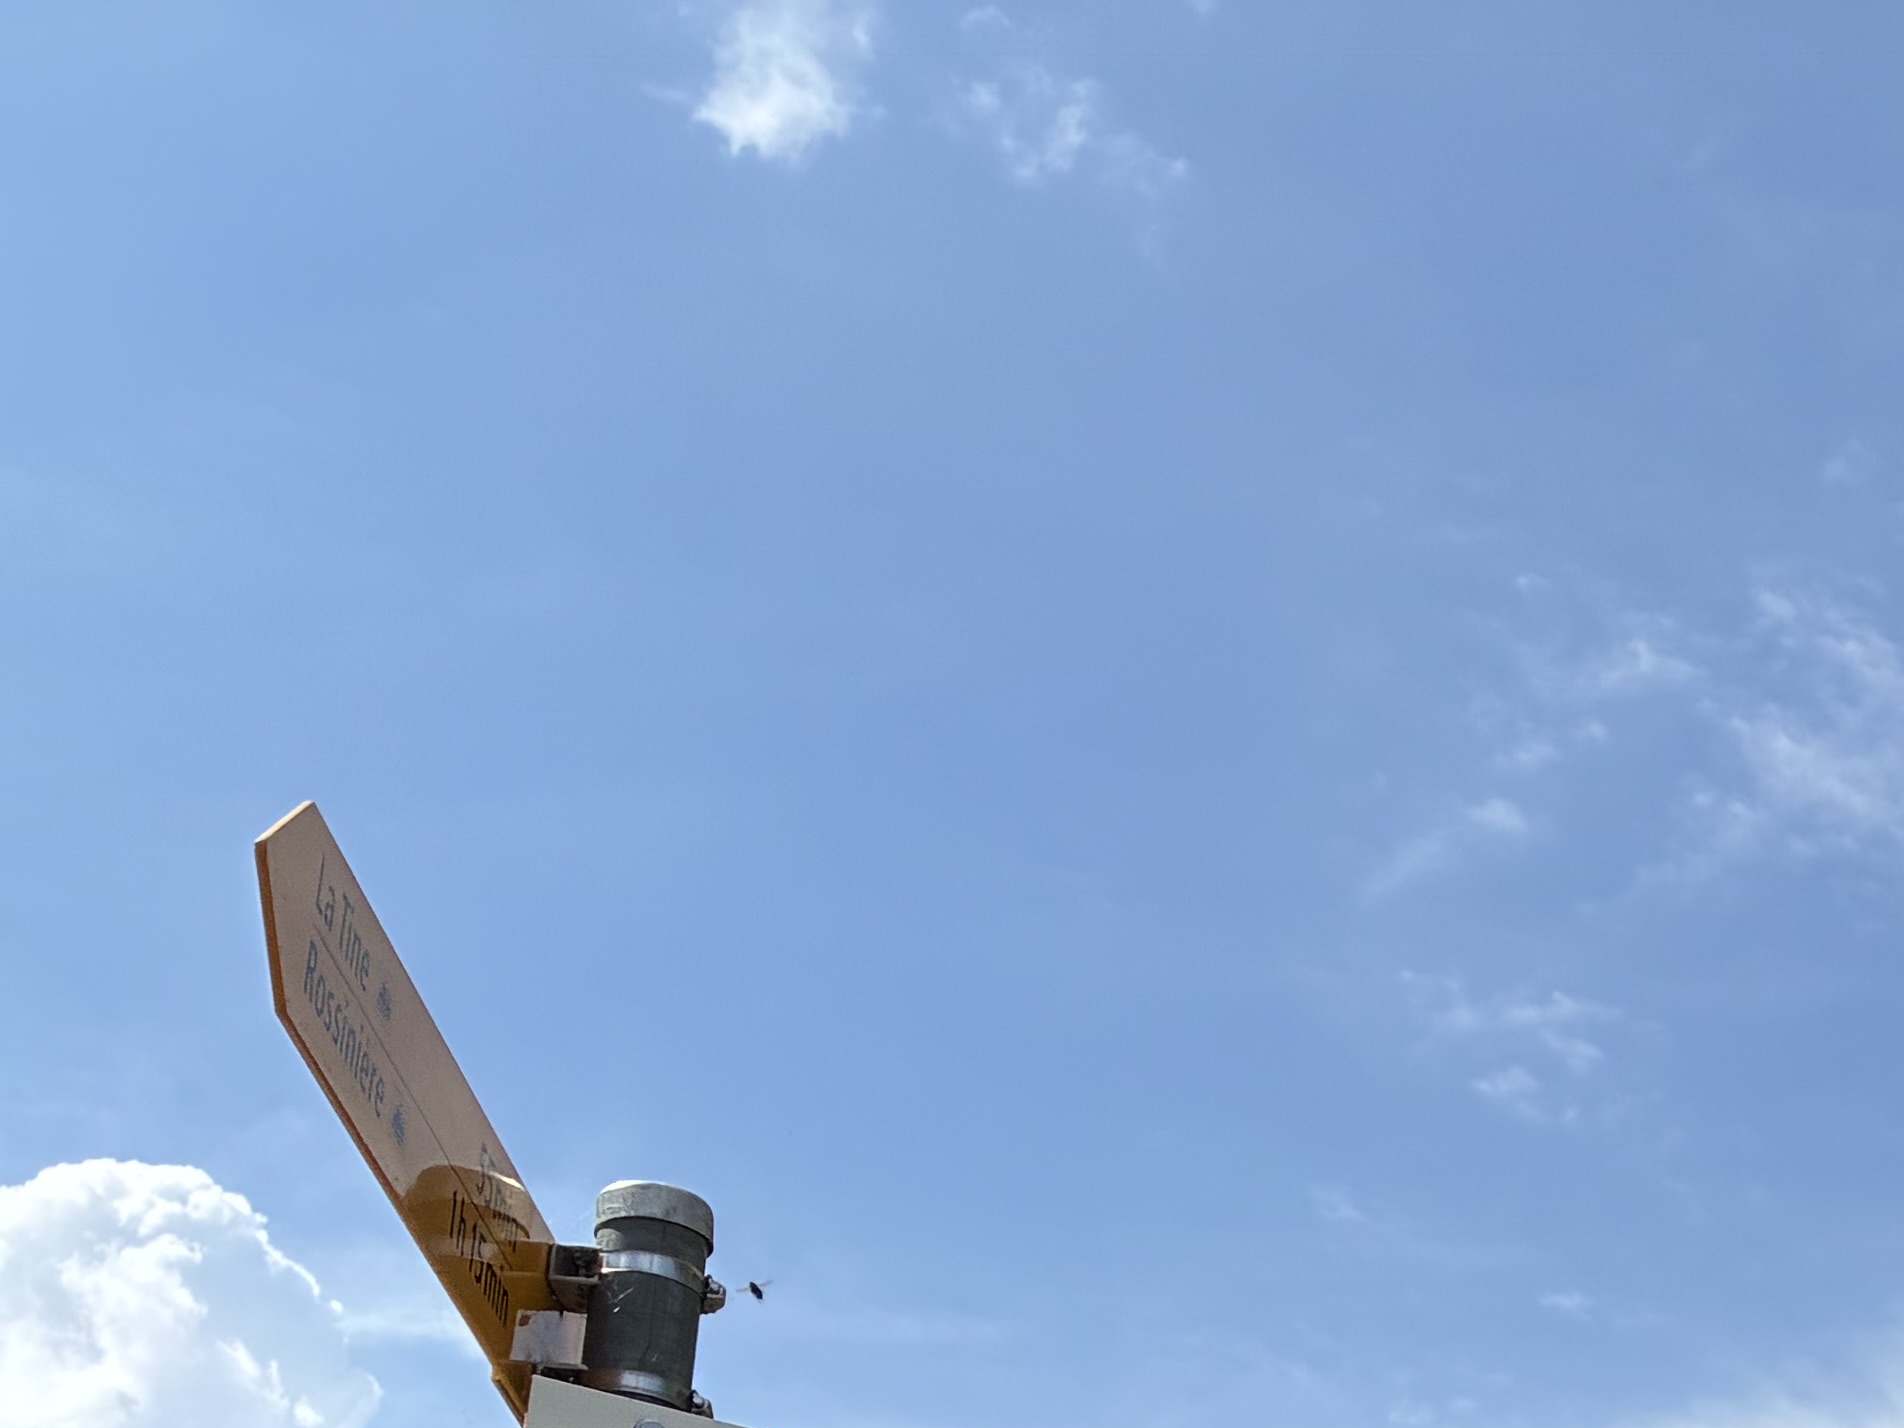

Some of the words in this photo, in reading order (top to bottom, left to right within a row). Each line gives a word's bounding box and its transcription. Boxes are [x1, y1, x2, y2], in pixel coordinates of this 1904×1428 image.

[315, 852, 336, 931] La
[340, 892, 370, 992] Tine
[304, 938, 385, 1117] Rossinière
